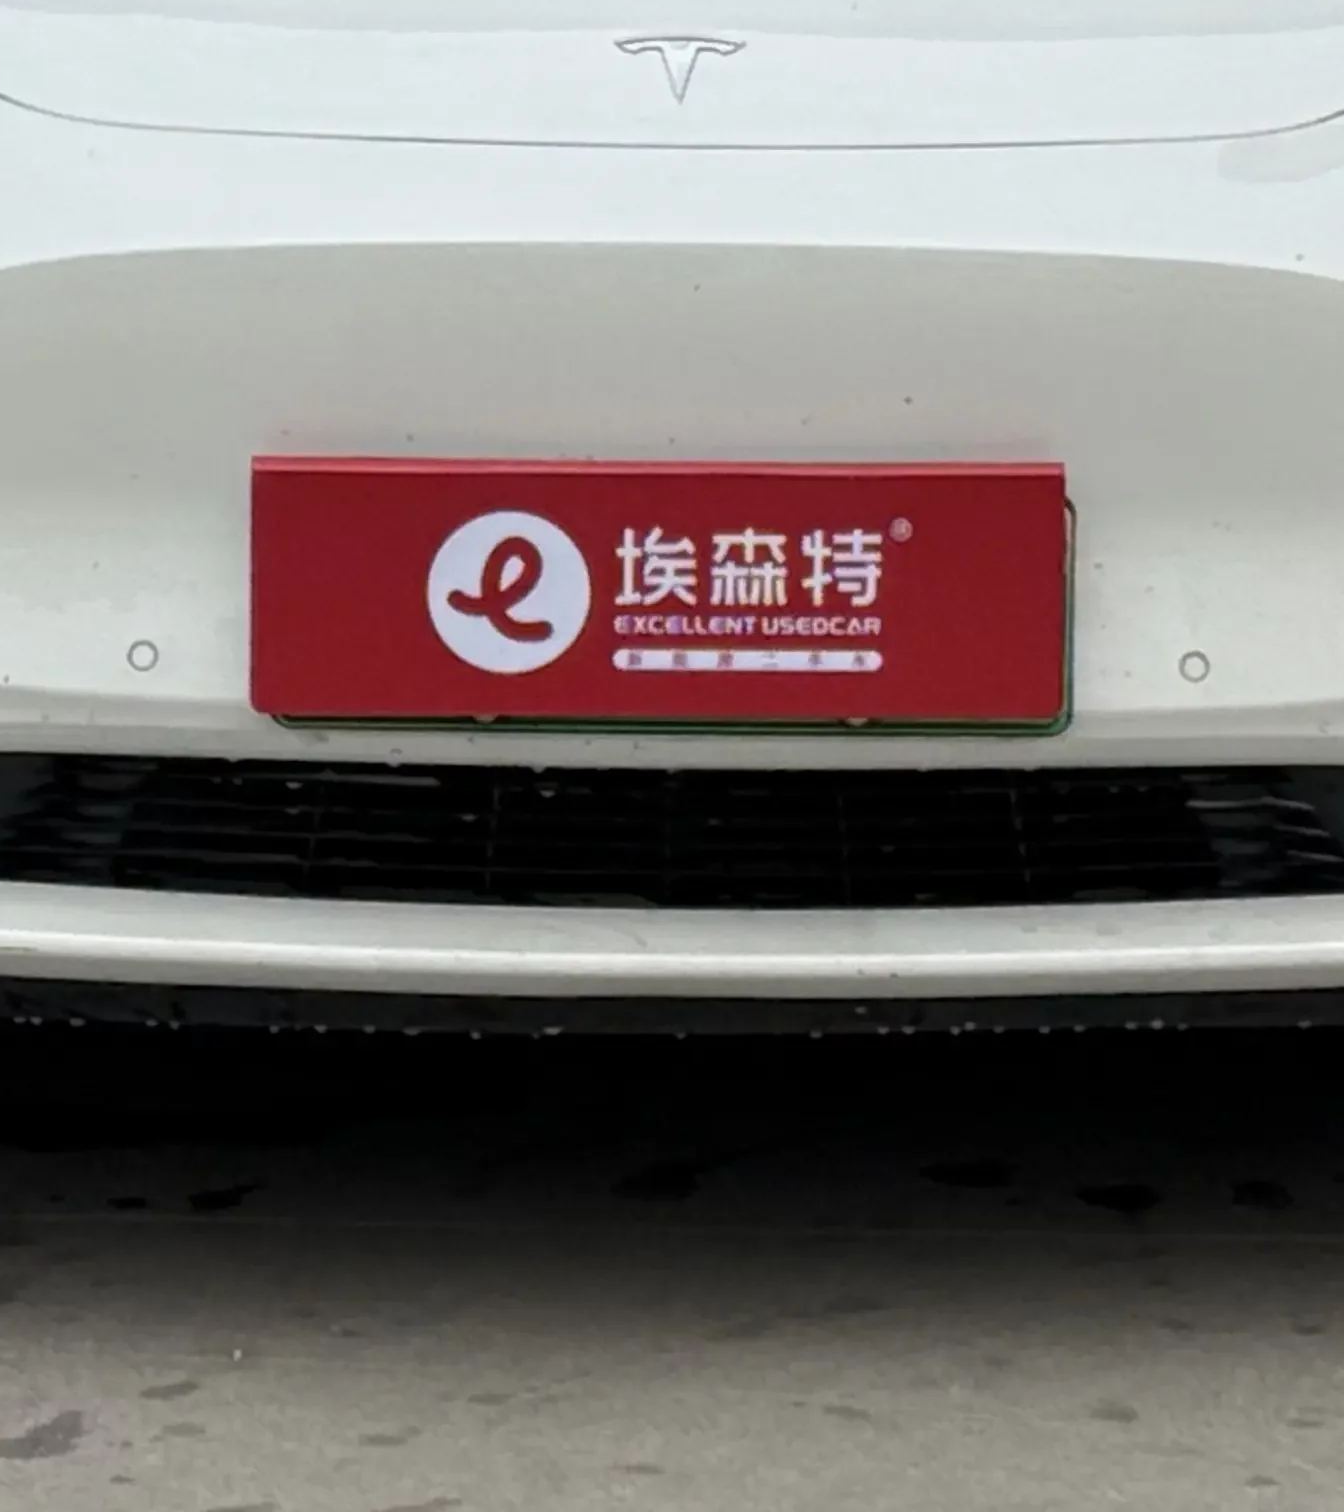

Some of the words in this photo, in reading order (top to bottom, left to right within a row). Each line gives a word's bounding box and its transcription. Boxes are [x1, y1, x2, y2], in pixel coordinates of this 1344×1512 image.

[614, 526, 883, 607] 埃森特
[612, 615, 756, 636] EXCELLENT
[761, 615, 883, 637] USEDCAR
